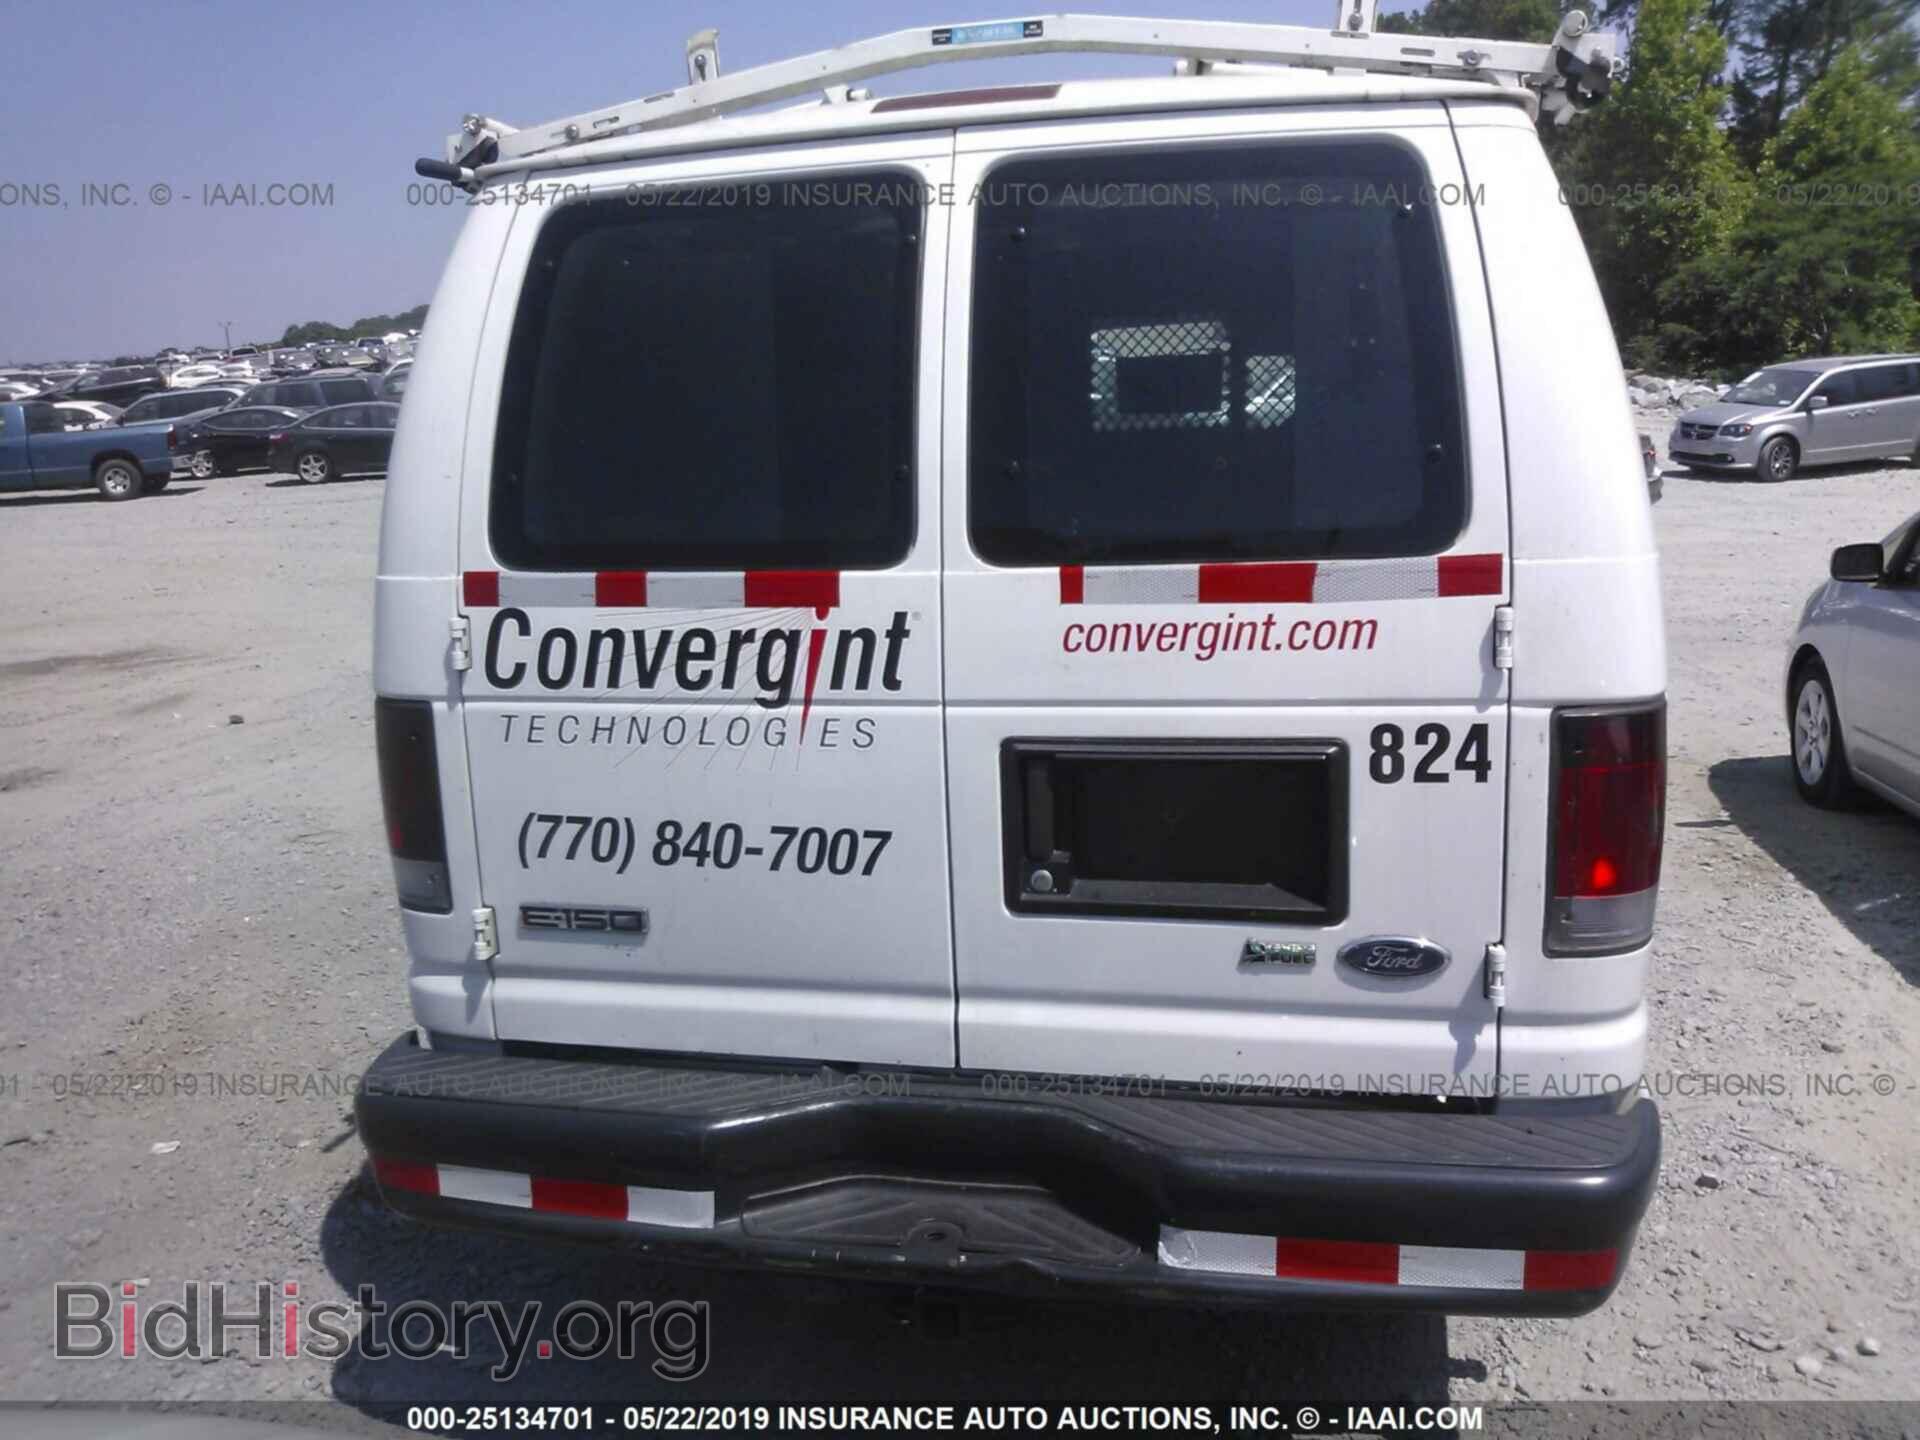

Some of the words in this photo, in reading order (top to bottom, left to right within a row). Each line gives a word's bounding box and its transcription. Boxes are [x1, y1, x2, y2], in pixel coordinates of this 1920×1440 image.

[484, 605, 911, 710] Convergint
[1062, 612, 1379, 661] convergint.com
[500, 714, 878, 749] TECHNOLOGIES
[1368, 723, 1492, 784] 824
[517, 812, 636, 874] (770)
[651, 820, 893, 876] 840-7007
[1363, 944, 1423, 971] Ford
